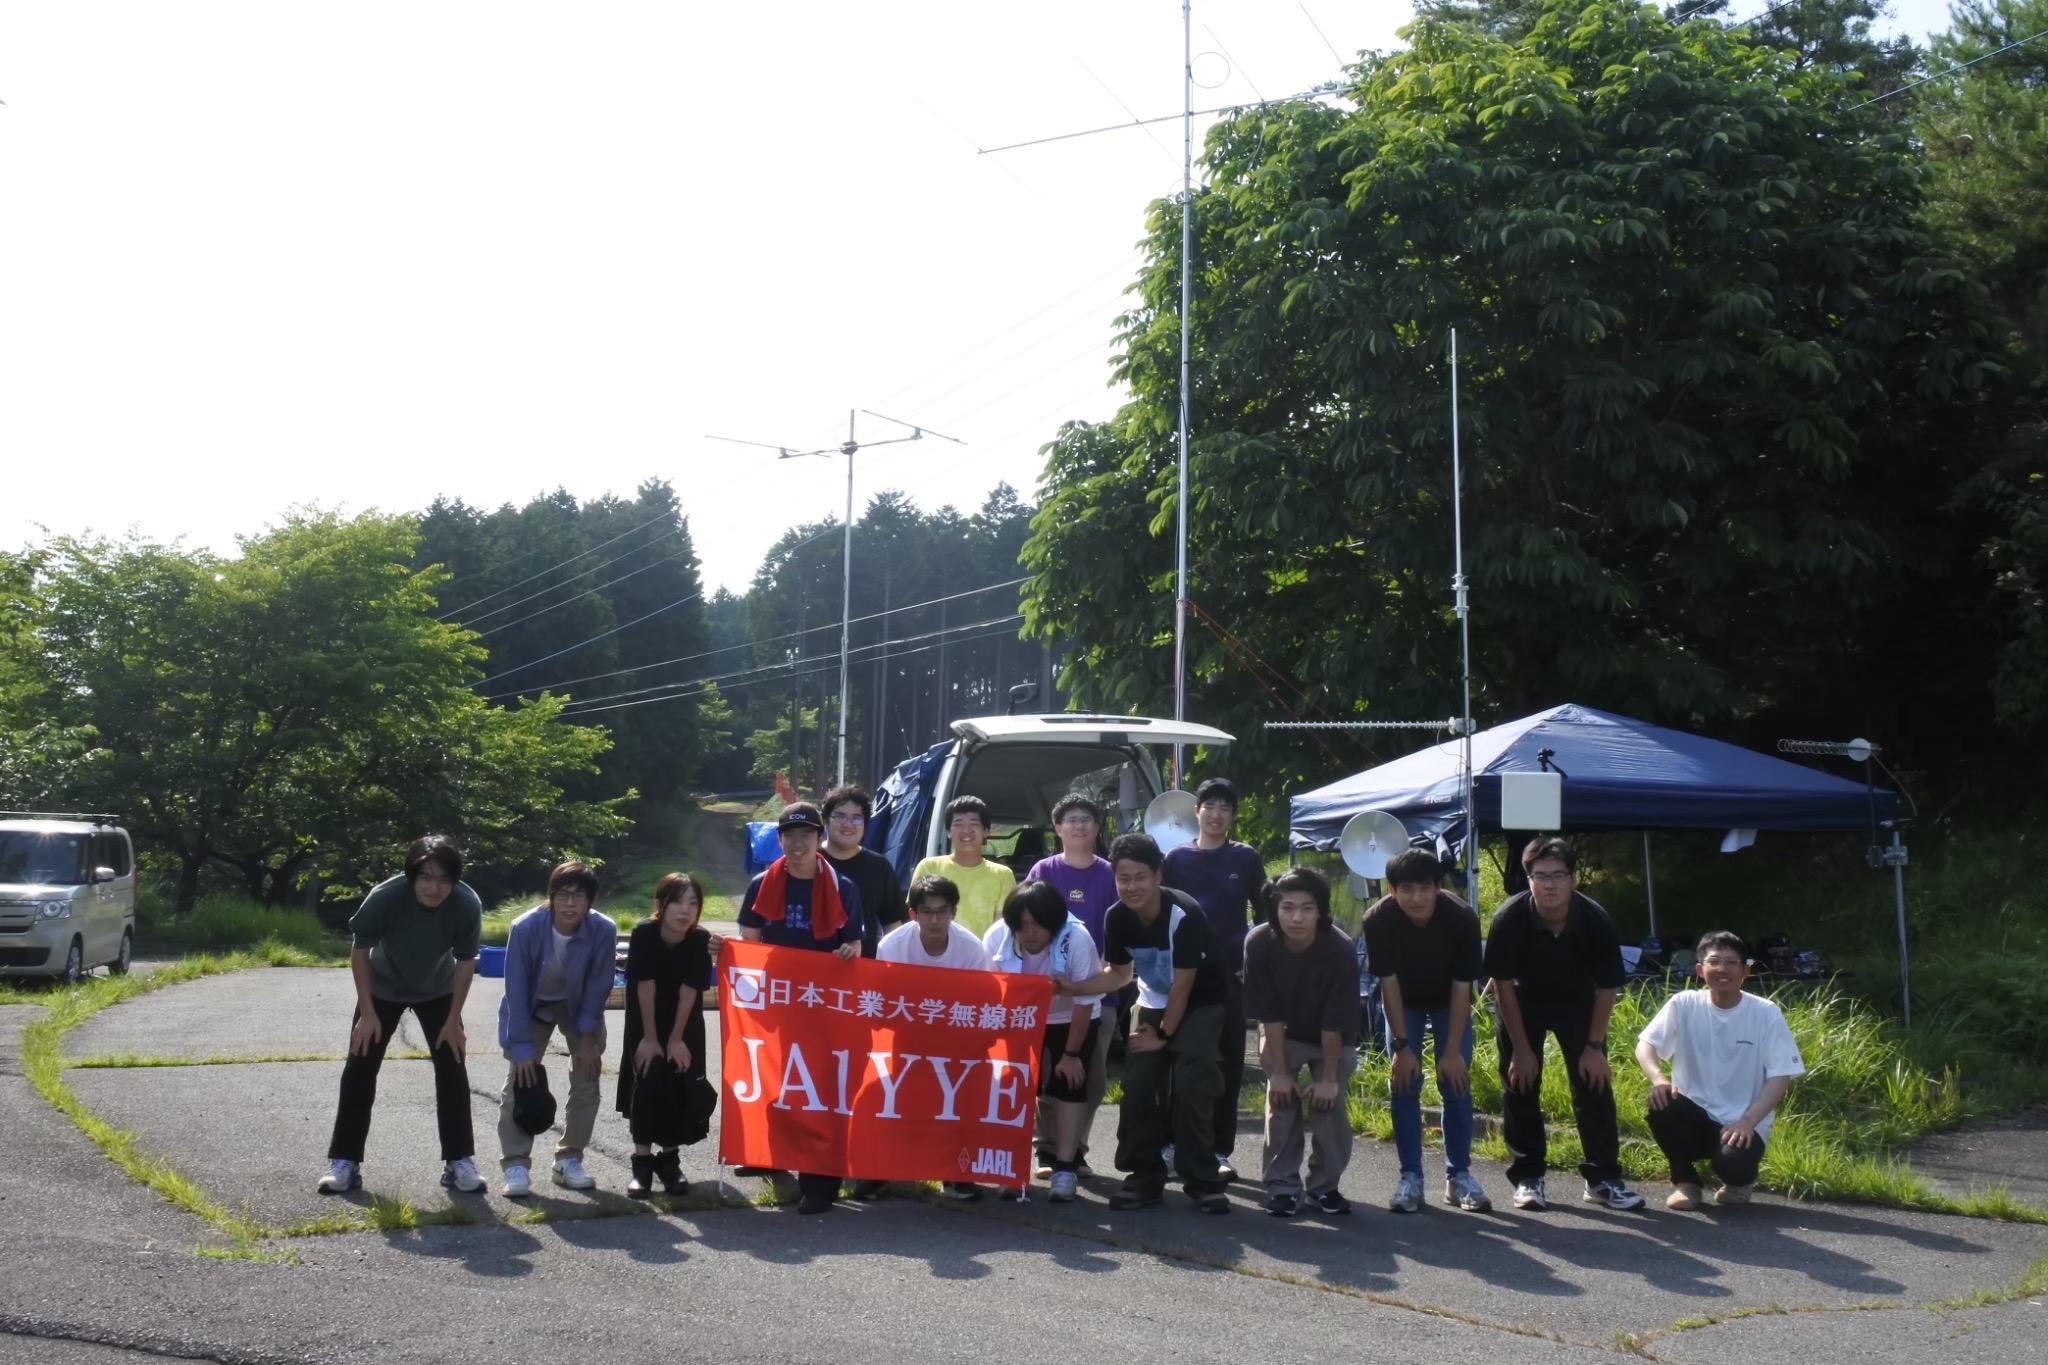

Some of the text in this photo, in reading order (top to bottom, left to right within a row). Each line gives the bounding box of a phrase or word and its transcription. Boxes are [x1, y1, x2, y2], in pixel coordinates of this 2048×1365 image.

[769, 978, 1038, 1030] 日本工業大学無線部
[733, 1036, 1029, 1128] JA1YYE
[971, 1147, 1017, 1178] JARL
